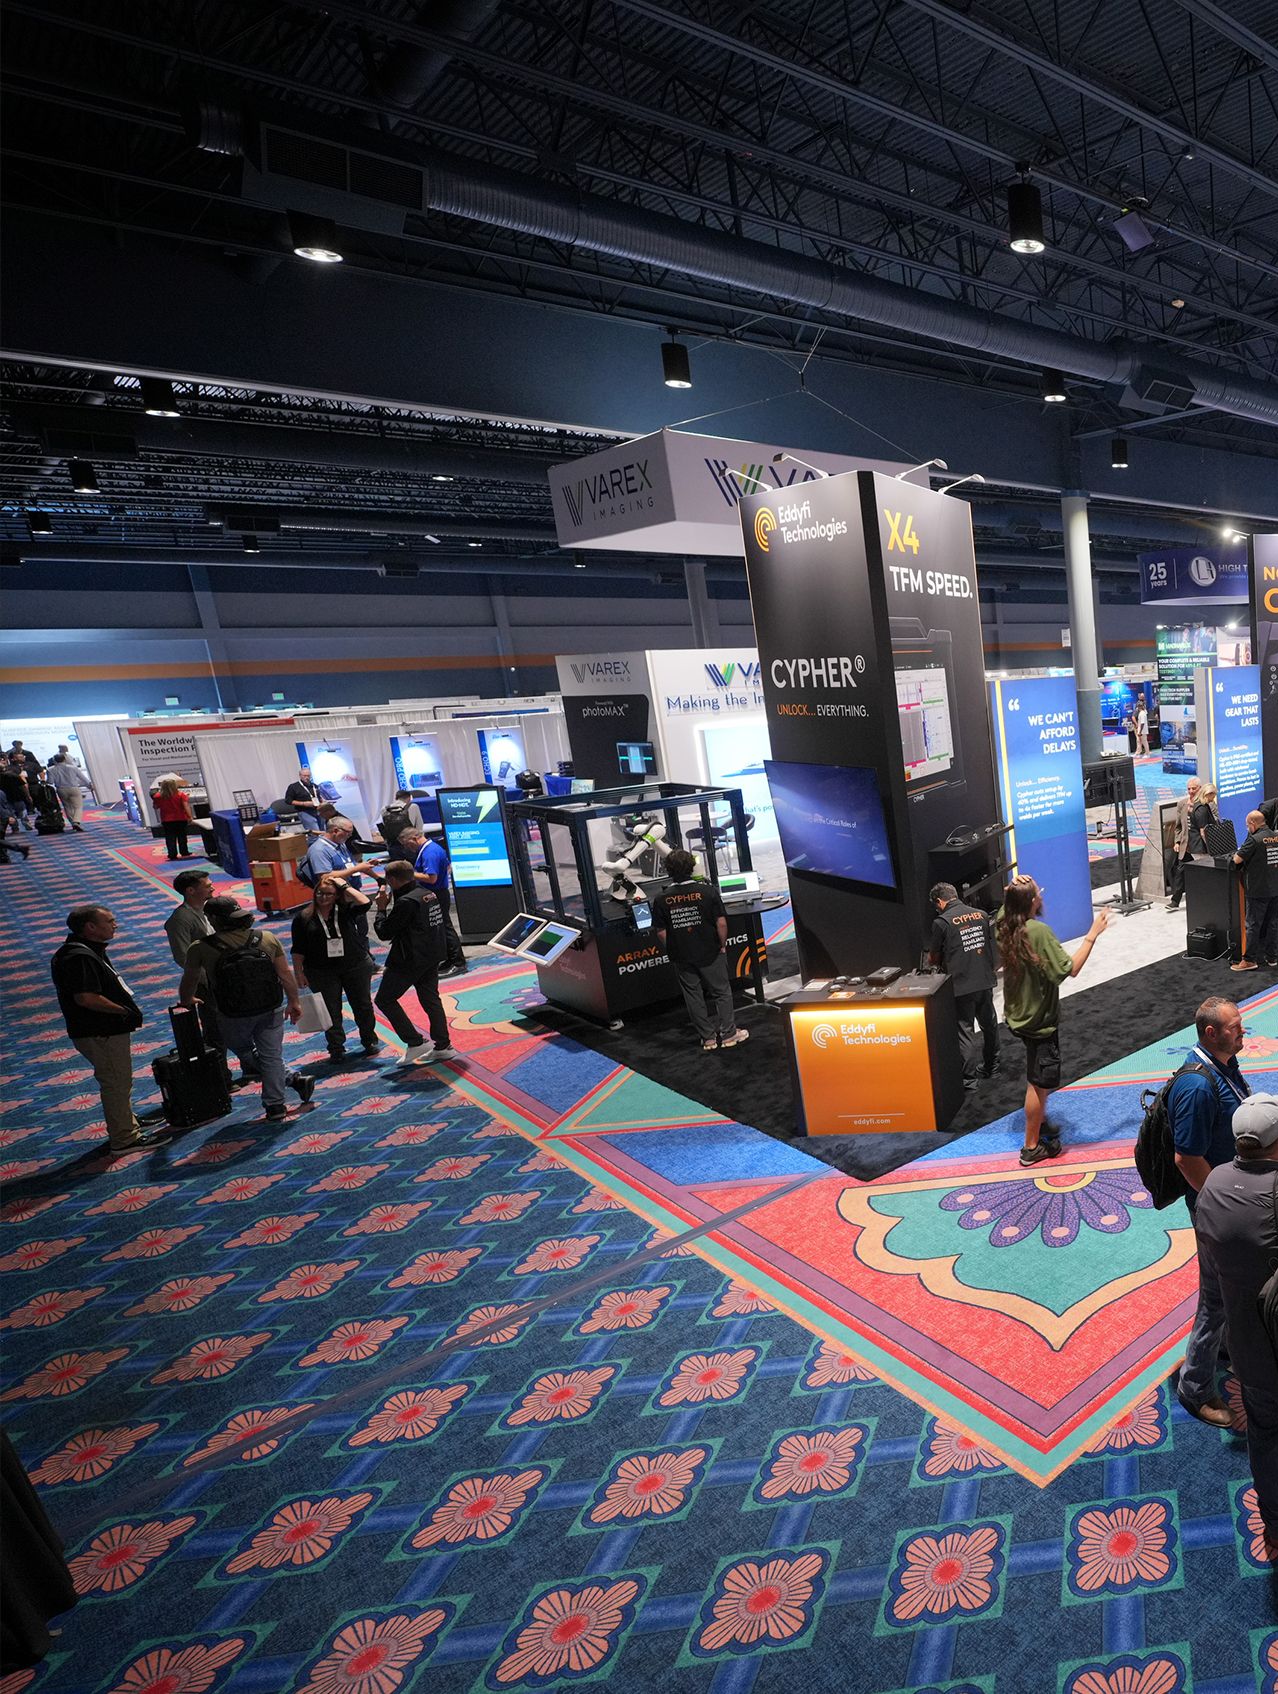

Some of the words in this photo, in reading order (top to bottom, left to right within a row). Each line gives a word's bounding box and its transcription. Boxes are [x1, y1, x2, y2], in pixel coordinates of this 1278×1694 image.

[585, 459, 653, 504] VAREX
[593, 497, 655, 521] IMAGING
[778, 500, 811, 525] Eddyfi
[780, 519, 848, 544] Technologies
[884, 508, 920, 555] X4
[1149, 562, 1167, 580] 25
[1218, 564, 1241, 573] HIGH
[889, 566, 924, 594] TFM
[926, 570, 974, 599] SPEED.
[1151, 578, 1167, 589] years
[587, 661, 631, 675] VAREX
[771, 654, 866, 689] CYPHER®
[667, 695, 721, 711] Making
[725, 692, 748, 705] the
[1231, 695, 1242, 705] WE
[1243, 694, 1258, 703] NEED
[776, 704, 816, 716] UNLOCK...
[817, 704, 870, 717] EVERYTHING.
[1225, 707, 1243, 717] GEAR
[1243, 705, 1258, 714] THAT
[1028, 715, 1044, 727] WE
[1045, 712, 1074, 725] CAN'T
[1241, 717, 1259, 727] LASTS
[1040, 726, 1075, 740] AFFORD
[138, 739, 156, 747] The
[158, 736, 193, 746] Worldw
[1043, 740, 1076, 754] DELAYS
[140, 744, 189, 755] Inspection
[665, 892, 702, 904] CYPHER
[952, 912, 984, 925] CYPHER
[616, 945, 659, 964] ARRAY.
[618, 954, 670, 976] POWERE
[841, 1023, 876, 1035] Eddyfi
[841, 1033, 911, 1046] Technologies
[853, 1117, 891, 1126] eddyfi.com
